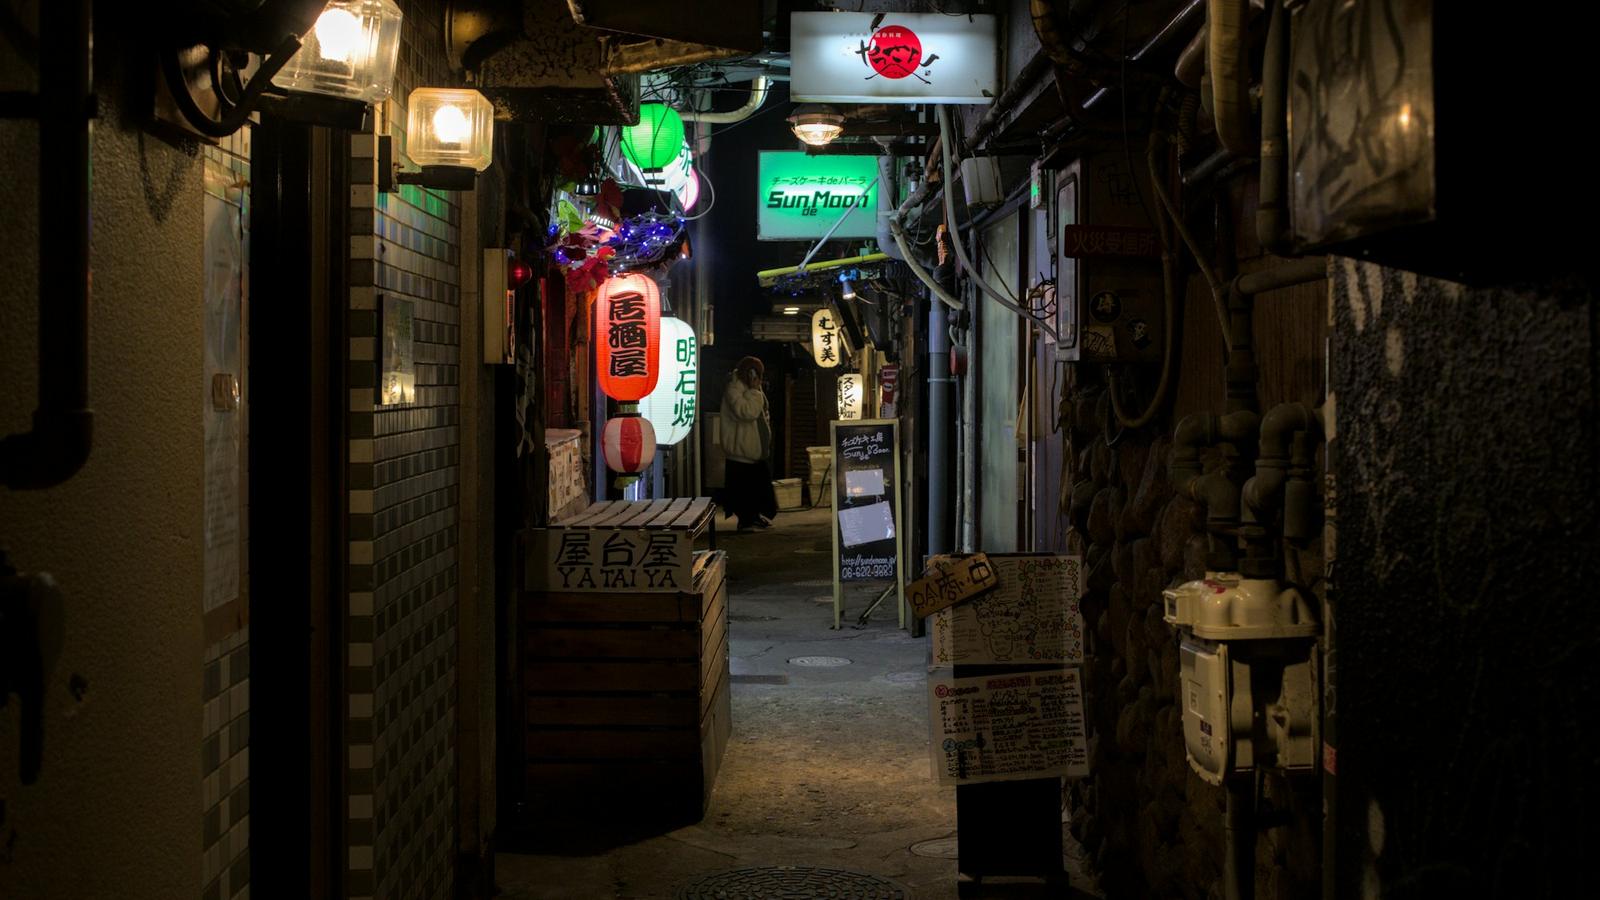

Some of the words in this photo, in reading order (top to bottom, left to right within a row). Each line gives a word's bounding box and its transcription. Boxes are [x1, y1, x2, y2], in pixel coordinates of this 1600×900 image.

[767, 191, 809, 208] Sun
[811, 191, 869, 208] Moon
[802, 207, 817, 217] de
[1072, 231, 1156, 256] 火災受信所
[608, 292, 648, 378] 居酒屋
[818, 316, 836, 363] むす美
[673, 337, 697, 427] 明石焼
[554, 532, 681, 568] 屋台屋
